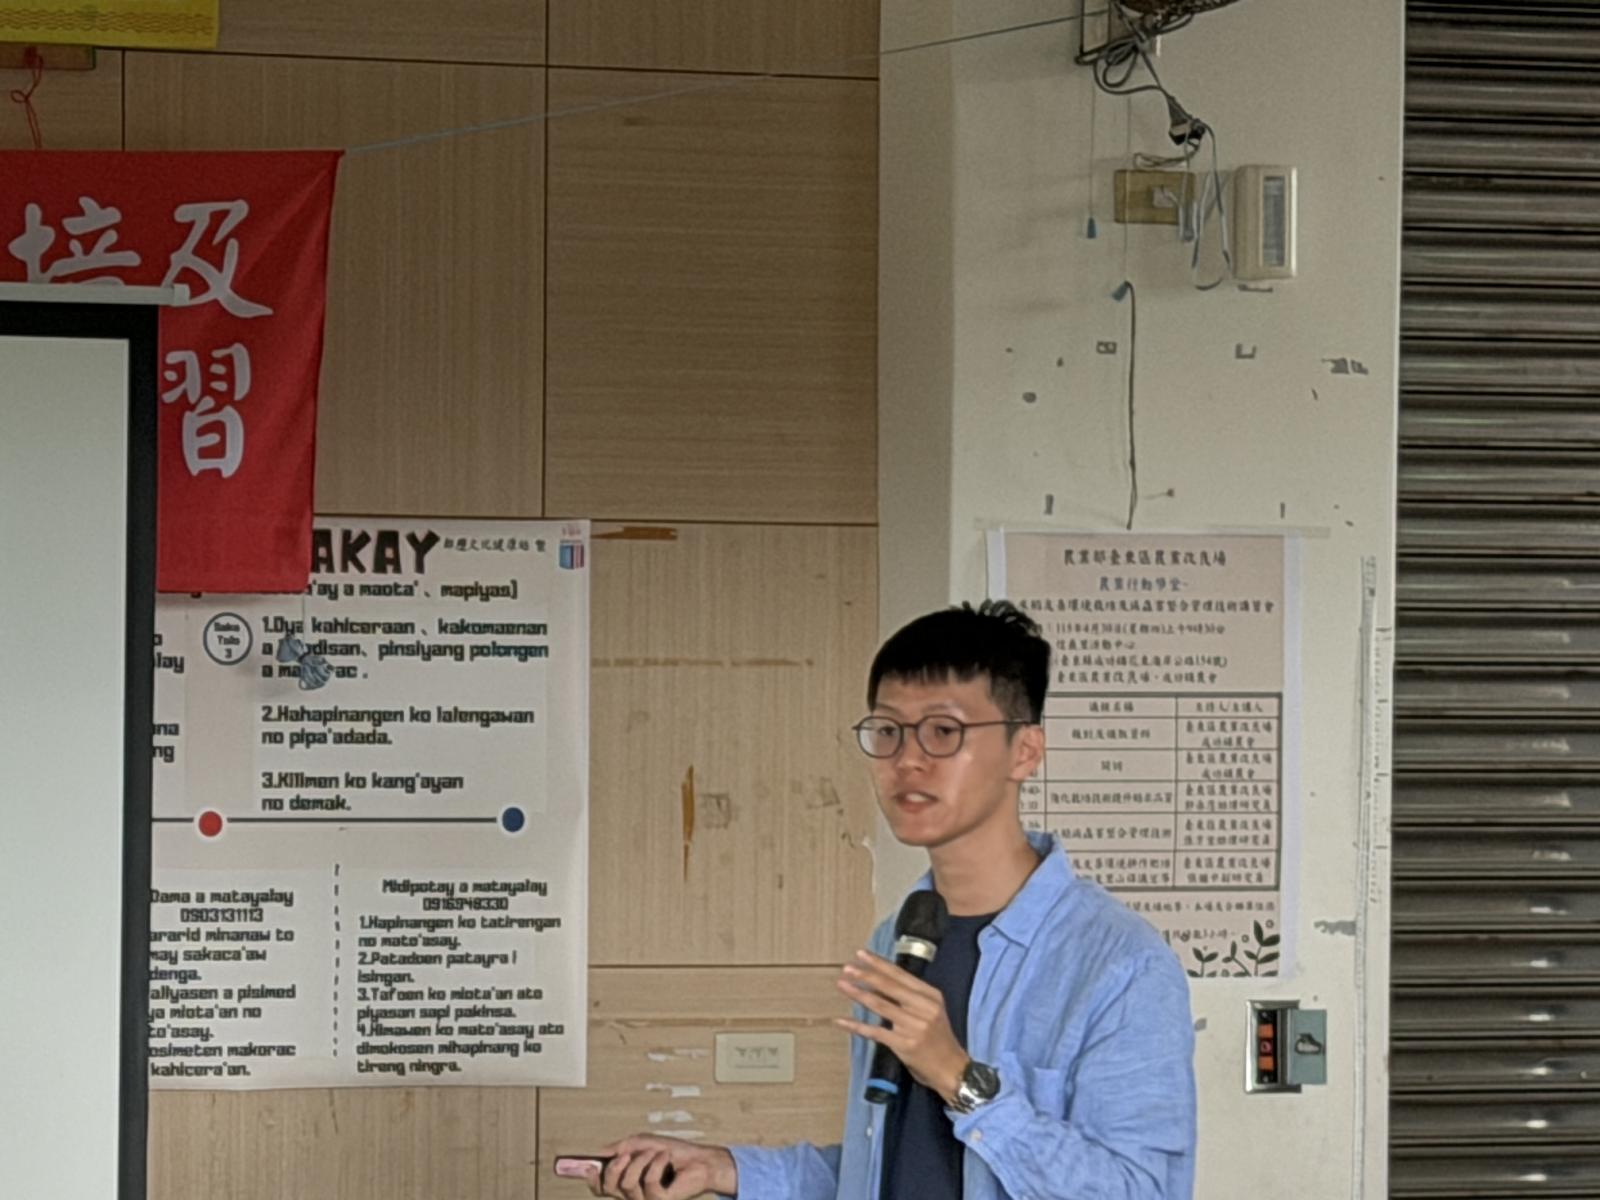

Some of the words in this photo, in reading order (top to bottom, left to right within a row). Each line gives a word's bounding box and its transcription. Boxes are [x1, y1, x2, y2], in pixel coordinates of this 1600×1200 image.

[162, 343, 250, 478] 習
[409, 705, 432, 723] ko
[261, 731, 284, 744] no
[344, 772, 367, 789] ko
[261, 798, 284, 811] no
